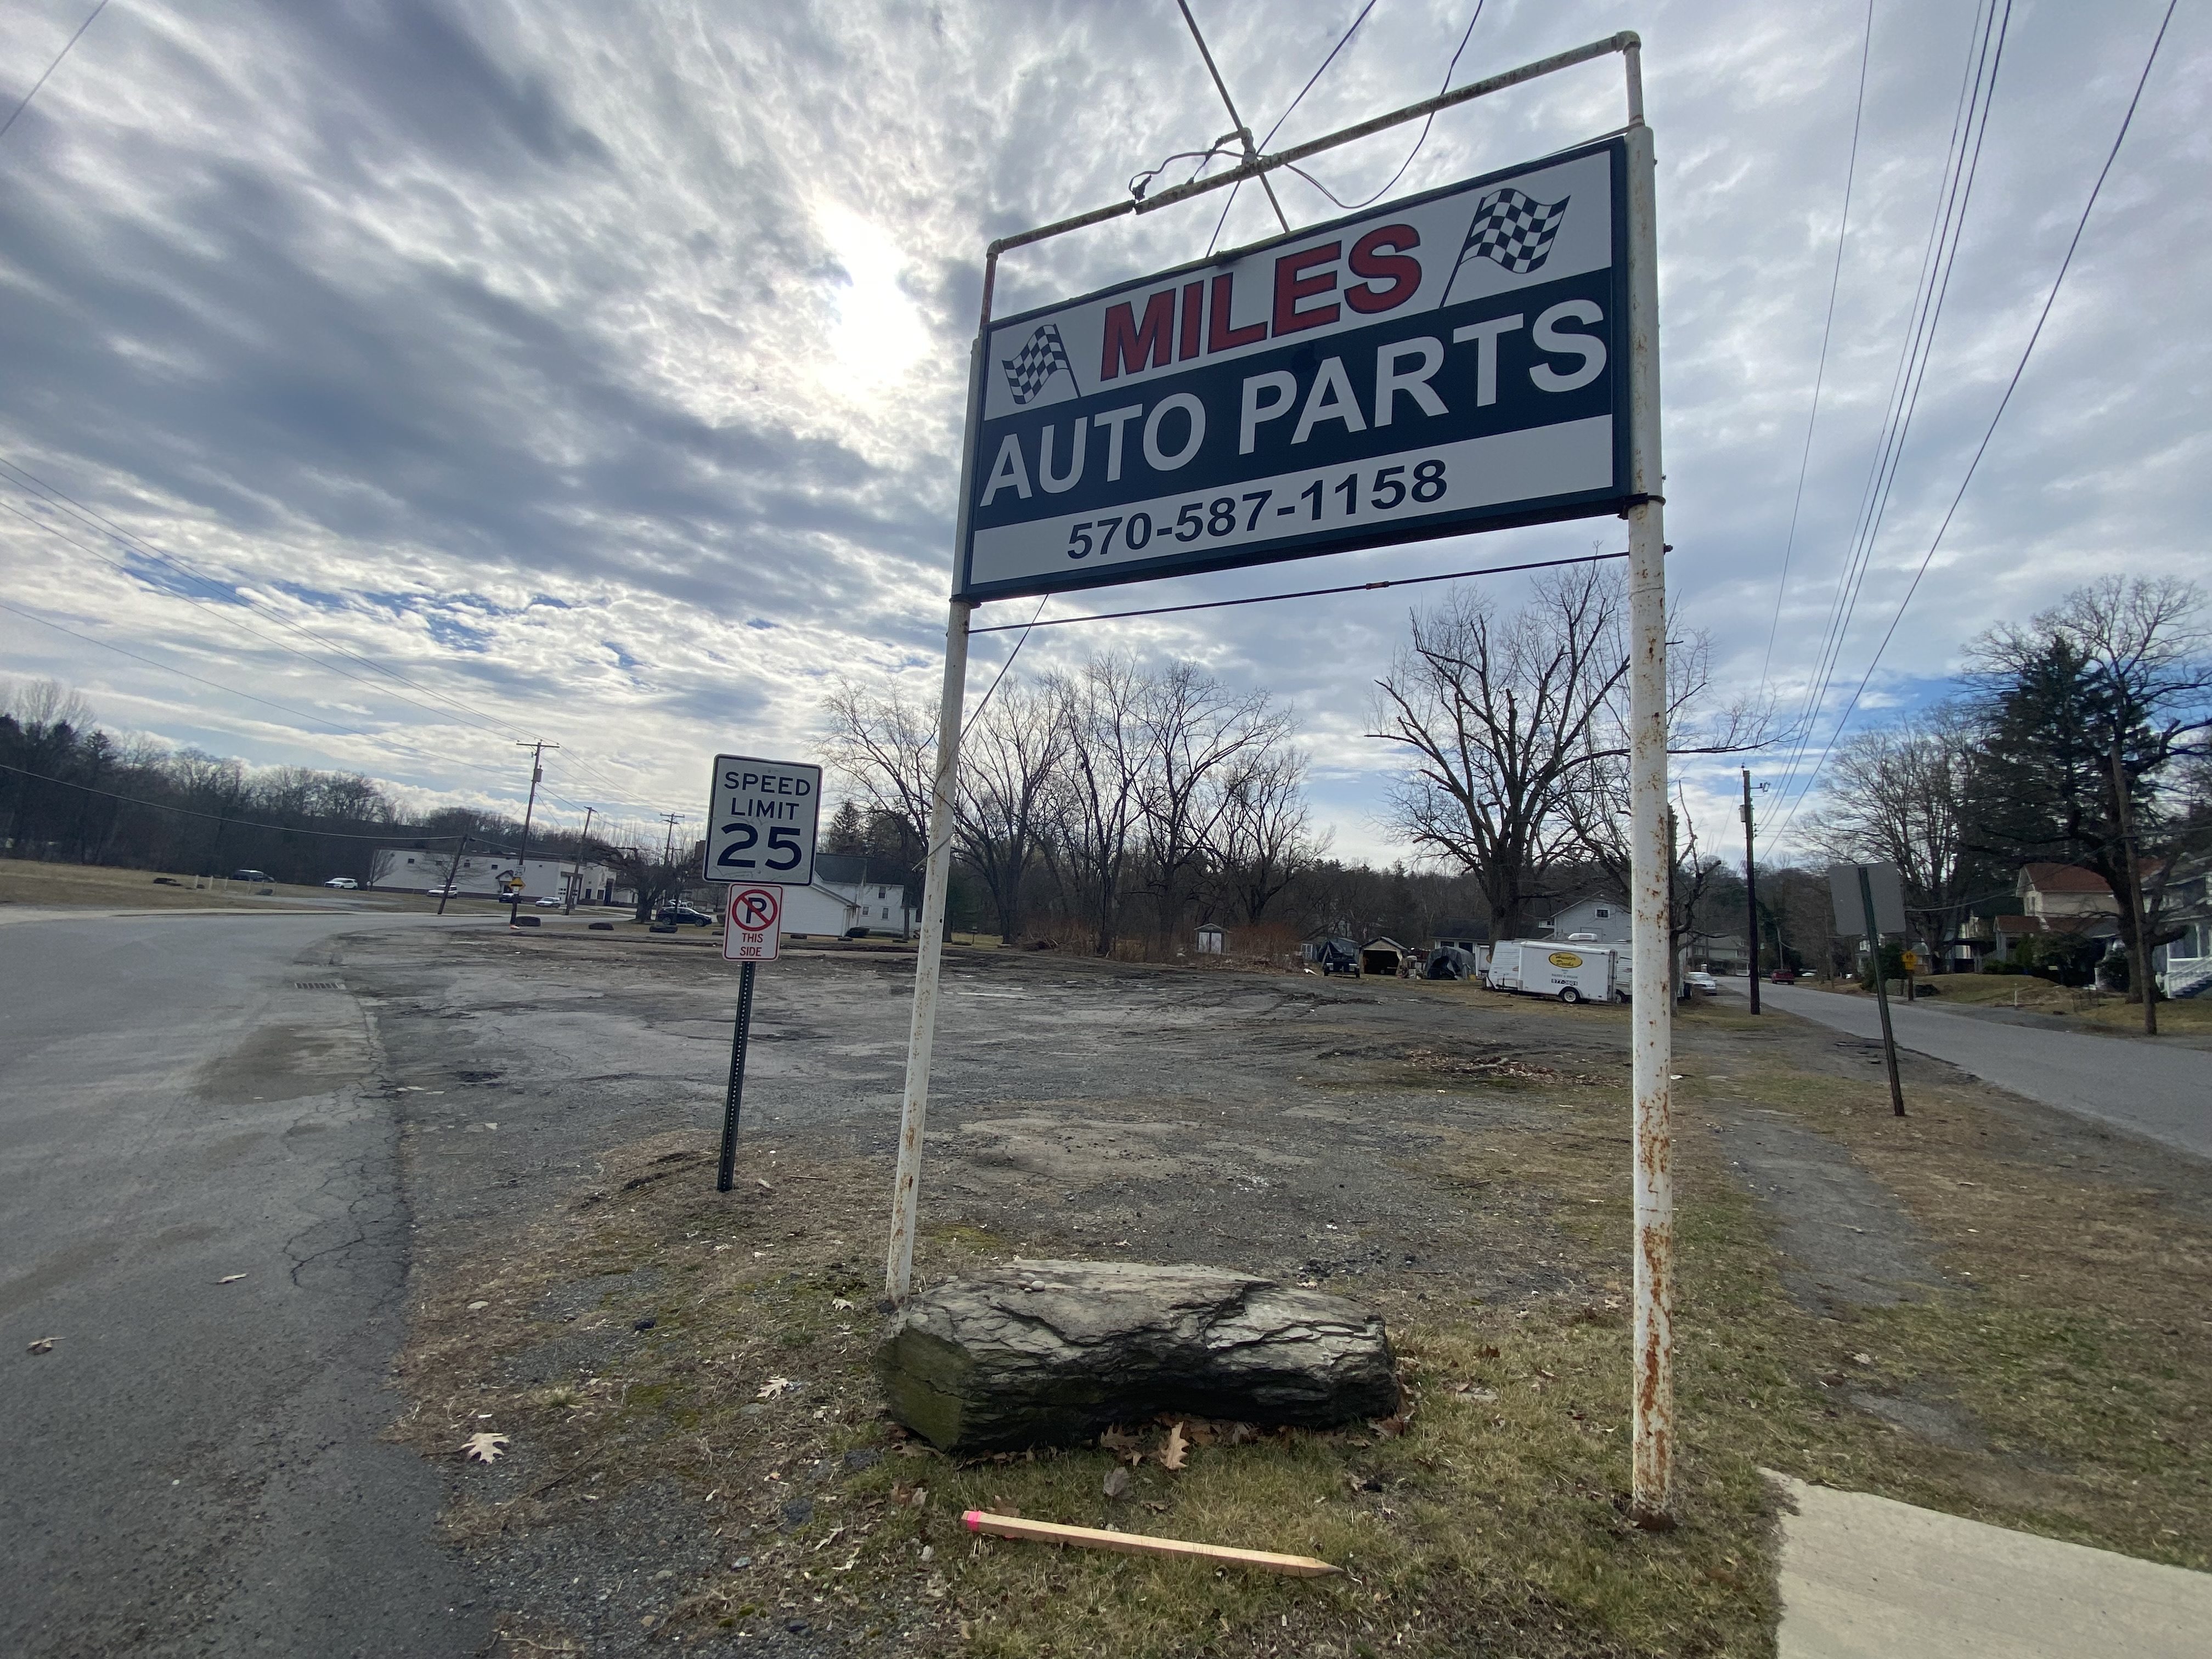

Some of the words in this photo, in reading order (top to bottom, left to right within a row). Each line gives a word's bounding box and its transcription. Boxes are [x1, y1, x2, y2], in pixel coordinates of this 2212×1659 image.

[1100, 224, 1422, 382] MILES
[980, 393, 1207, 507] AUTO
[1238, 298, 1608, 455] PARTS
[1067, 459, 1448, 560] 570-587-1158
[724, 771, 810, 796] SPEED
[731, 797, 799, 820] LIMIT
[716, 822, 802, 871] 25
[739, 946, 762, 957] SIDE
[742, 933, 763, 943] THIS
